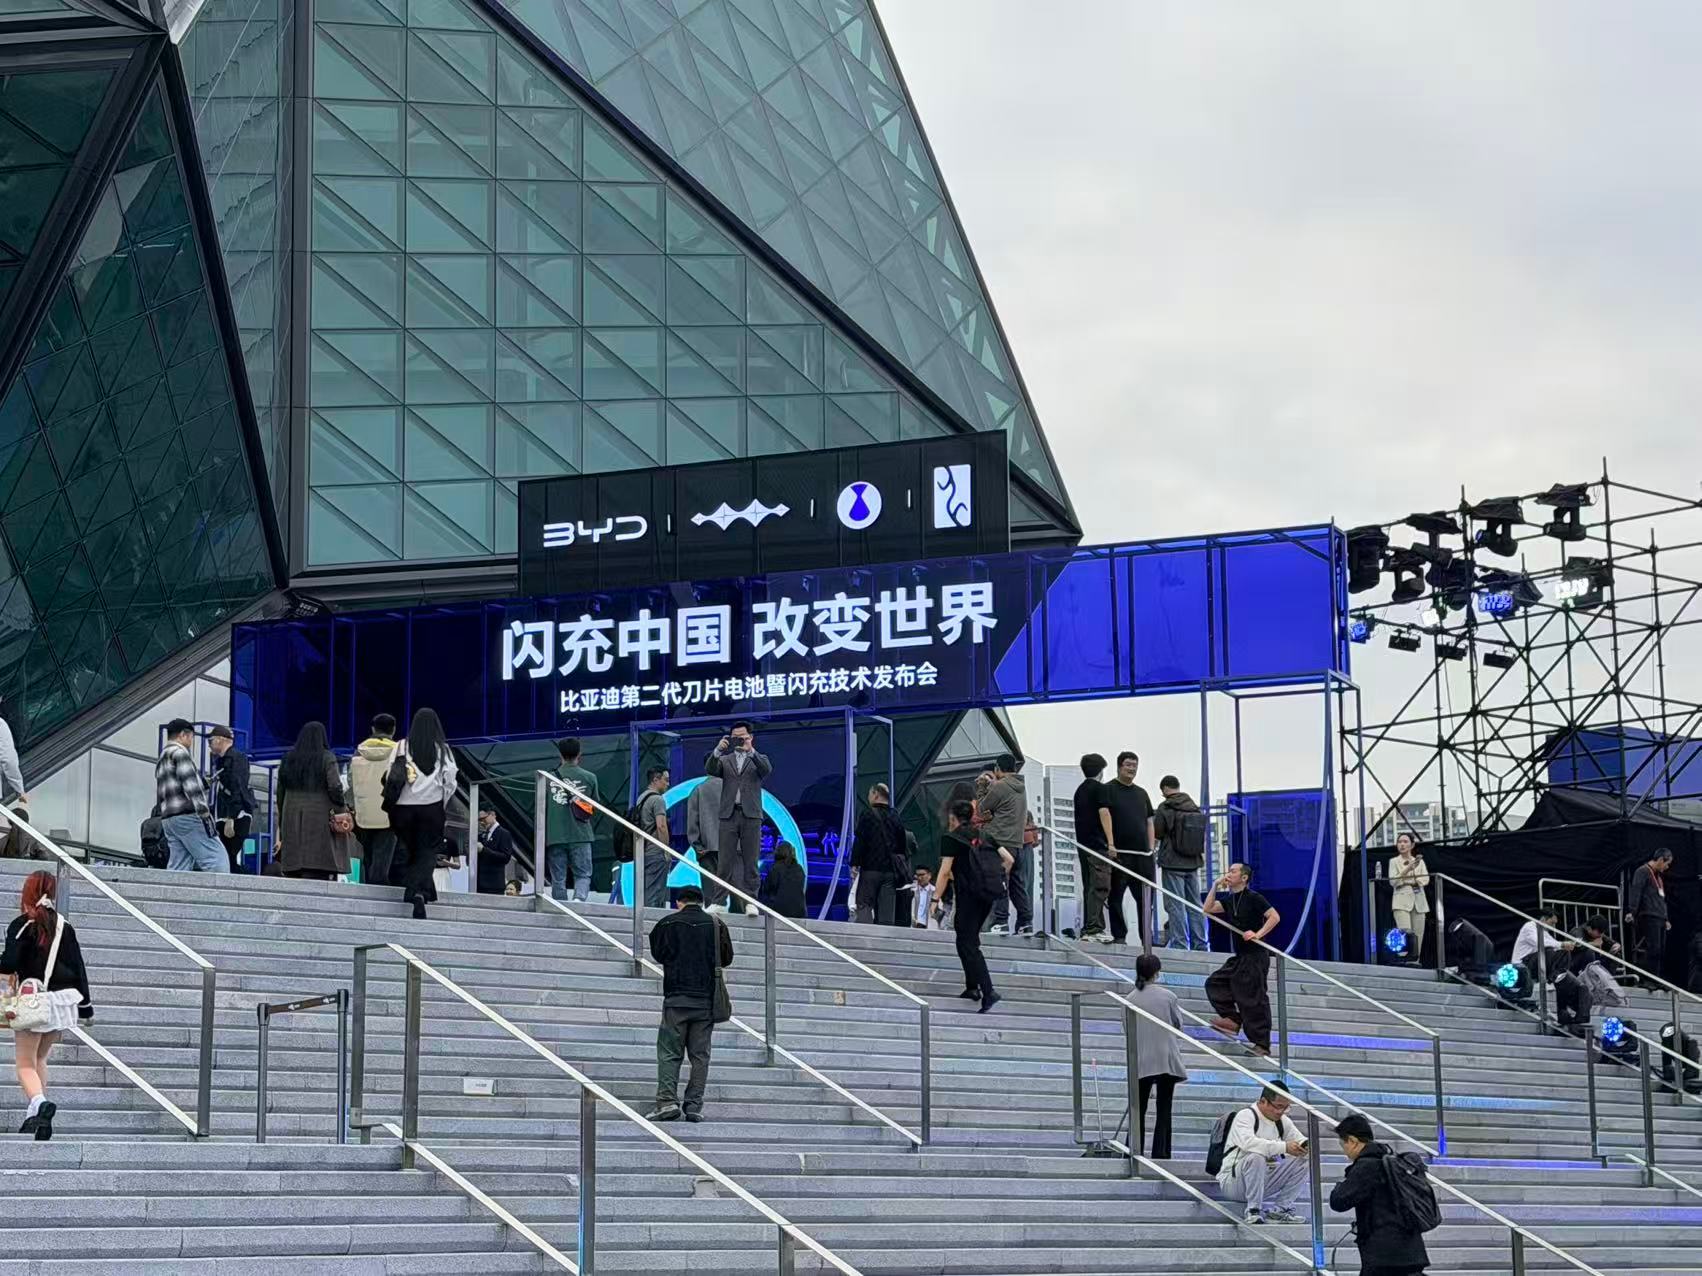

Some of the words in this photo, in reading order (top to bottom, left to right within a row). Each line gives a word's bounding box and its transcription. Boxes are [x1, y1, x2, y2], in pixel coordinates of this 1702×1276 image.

[544, 516, 648, 548] BYD
[503, 604, 731, 681] 闪充中国
[753, 582, 998, 660] 改变世界
[561, 661, 938, 713] 比亚迪第二代刀片电池暨闪充技术发布会
